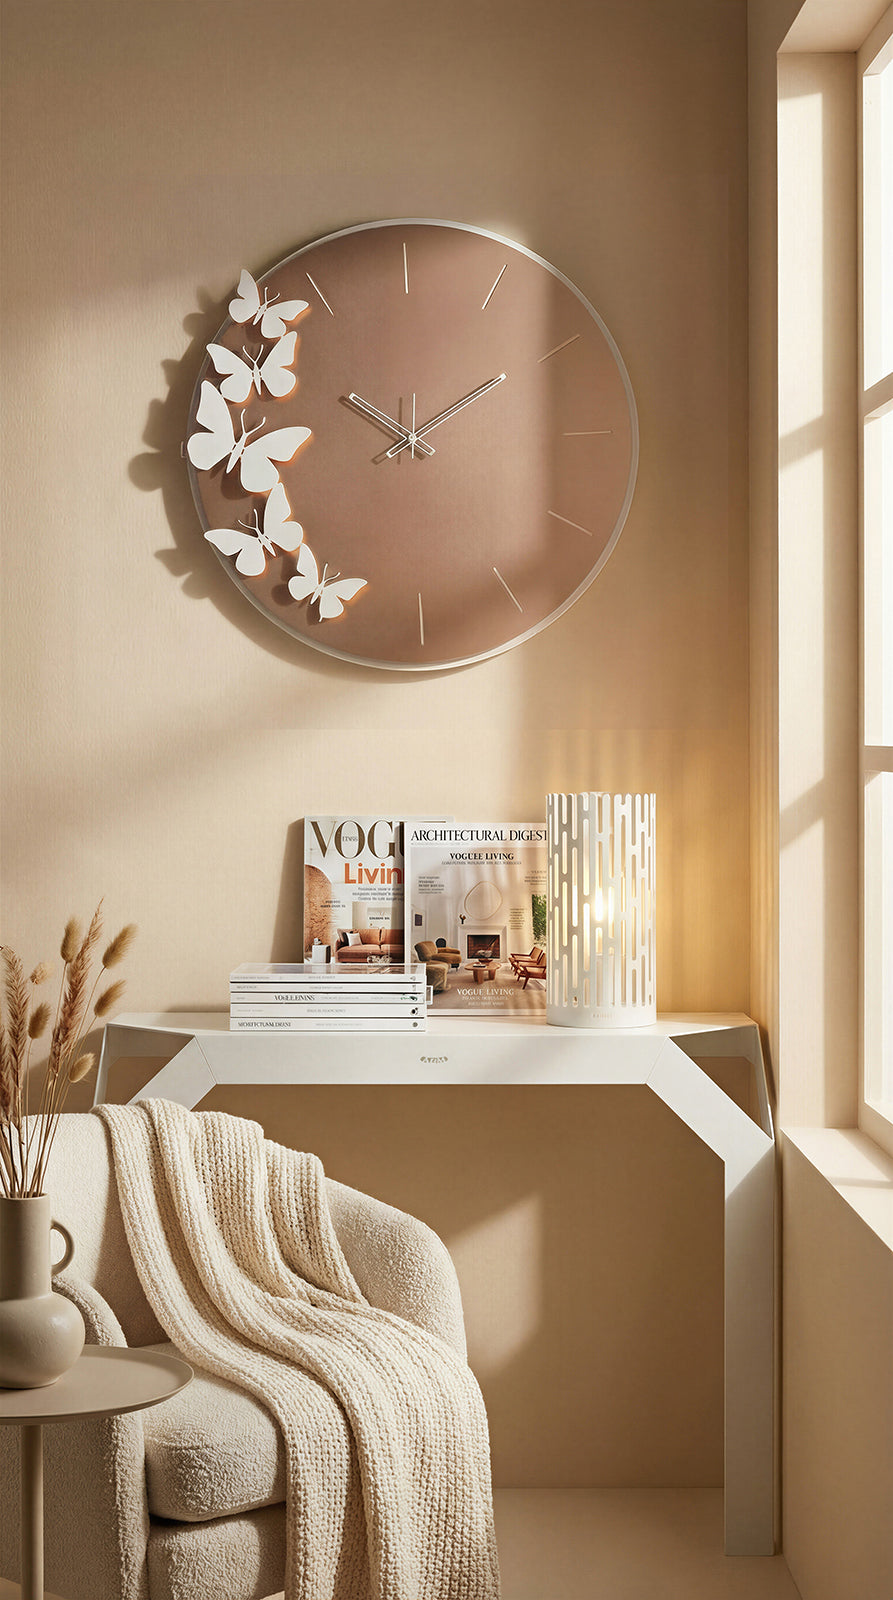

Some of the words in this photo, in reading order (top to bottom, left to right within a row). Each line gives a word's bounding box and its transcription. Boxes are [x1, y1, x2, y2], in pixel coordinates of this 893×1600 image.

[411, 829, 507, 841] ARCHITECTURAL
[485, 853, 514, 861] LIVING
[344, 862, 404, 885] Livin
[457, 988, 484, 996] VOGUE
[486, 988, 514, 996] LIVING
